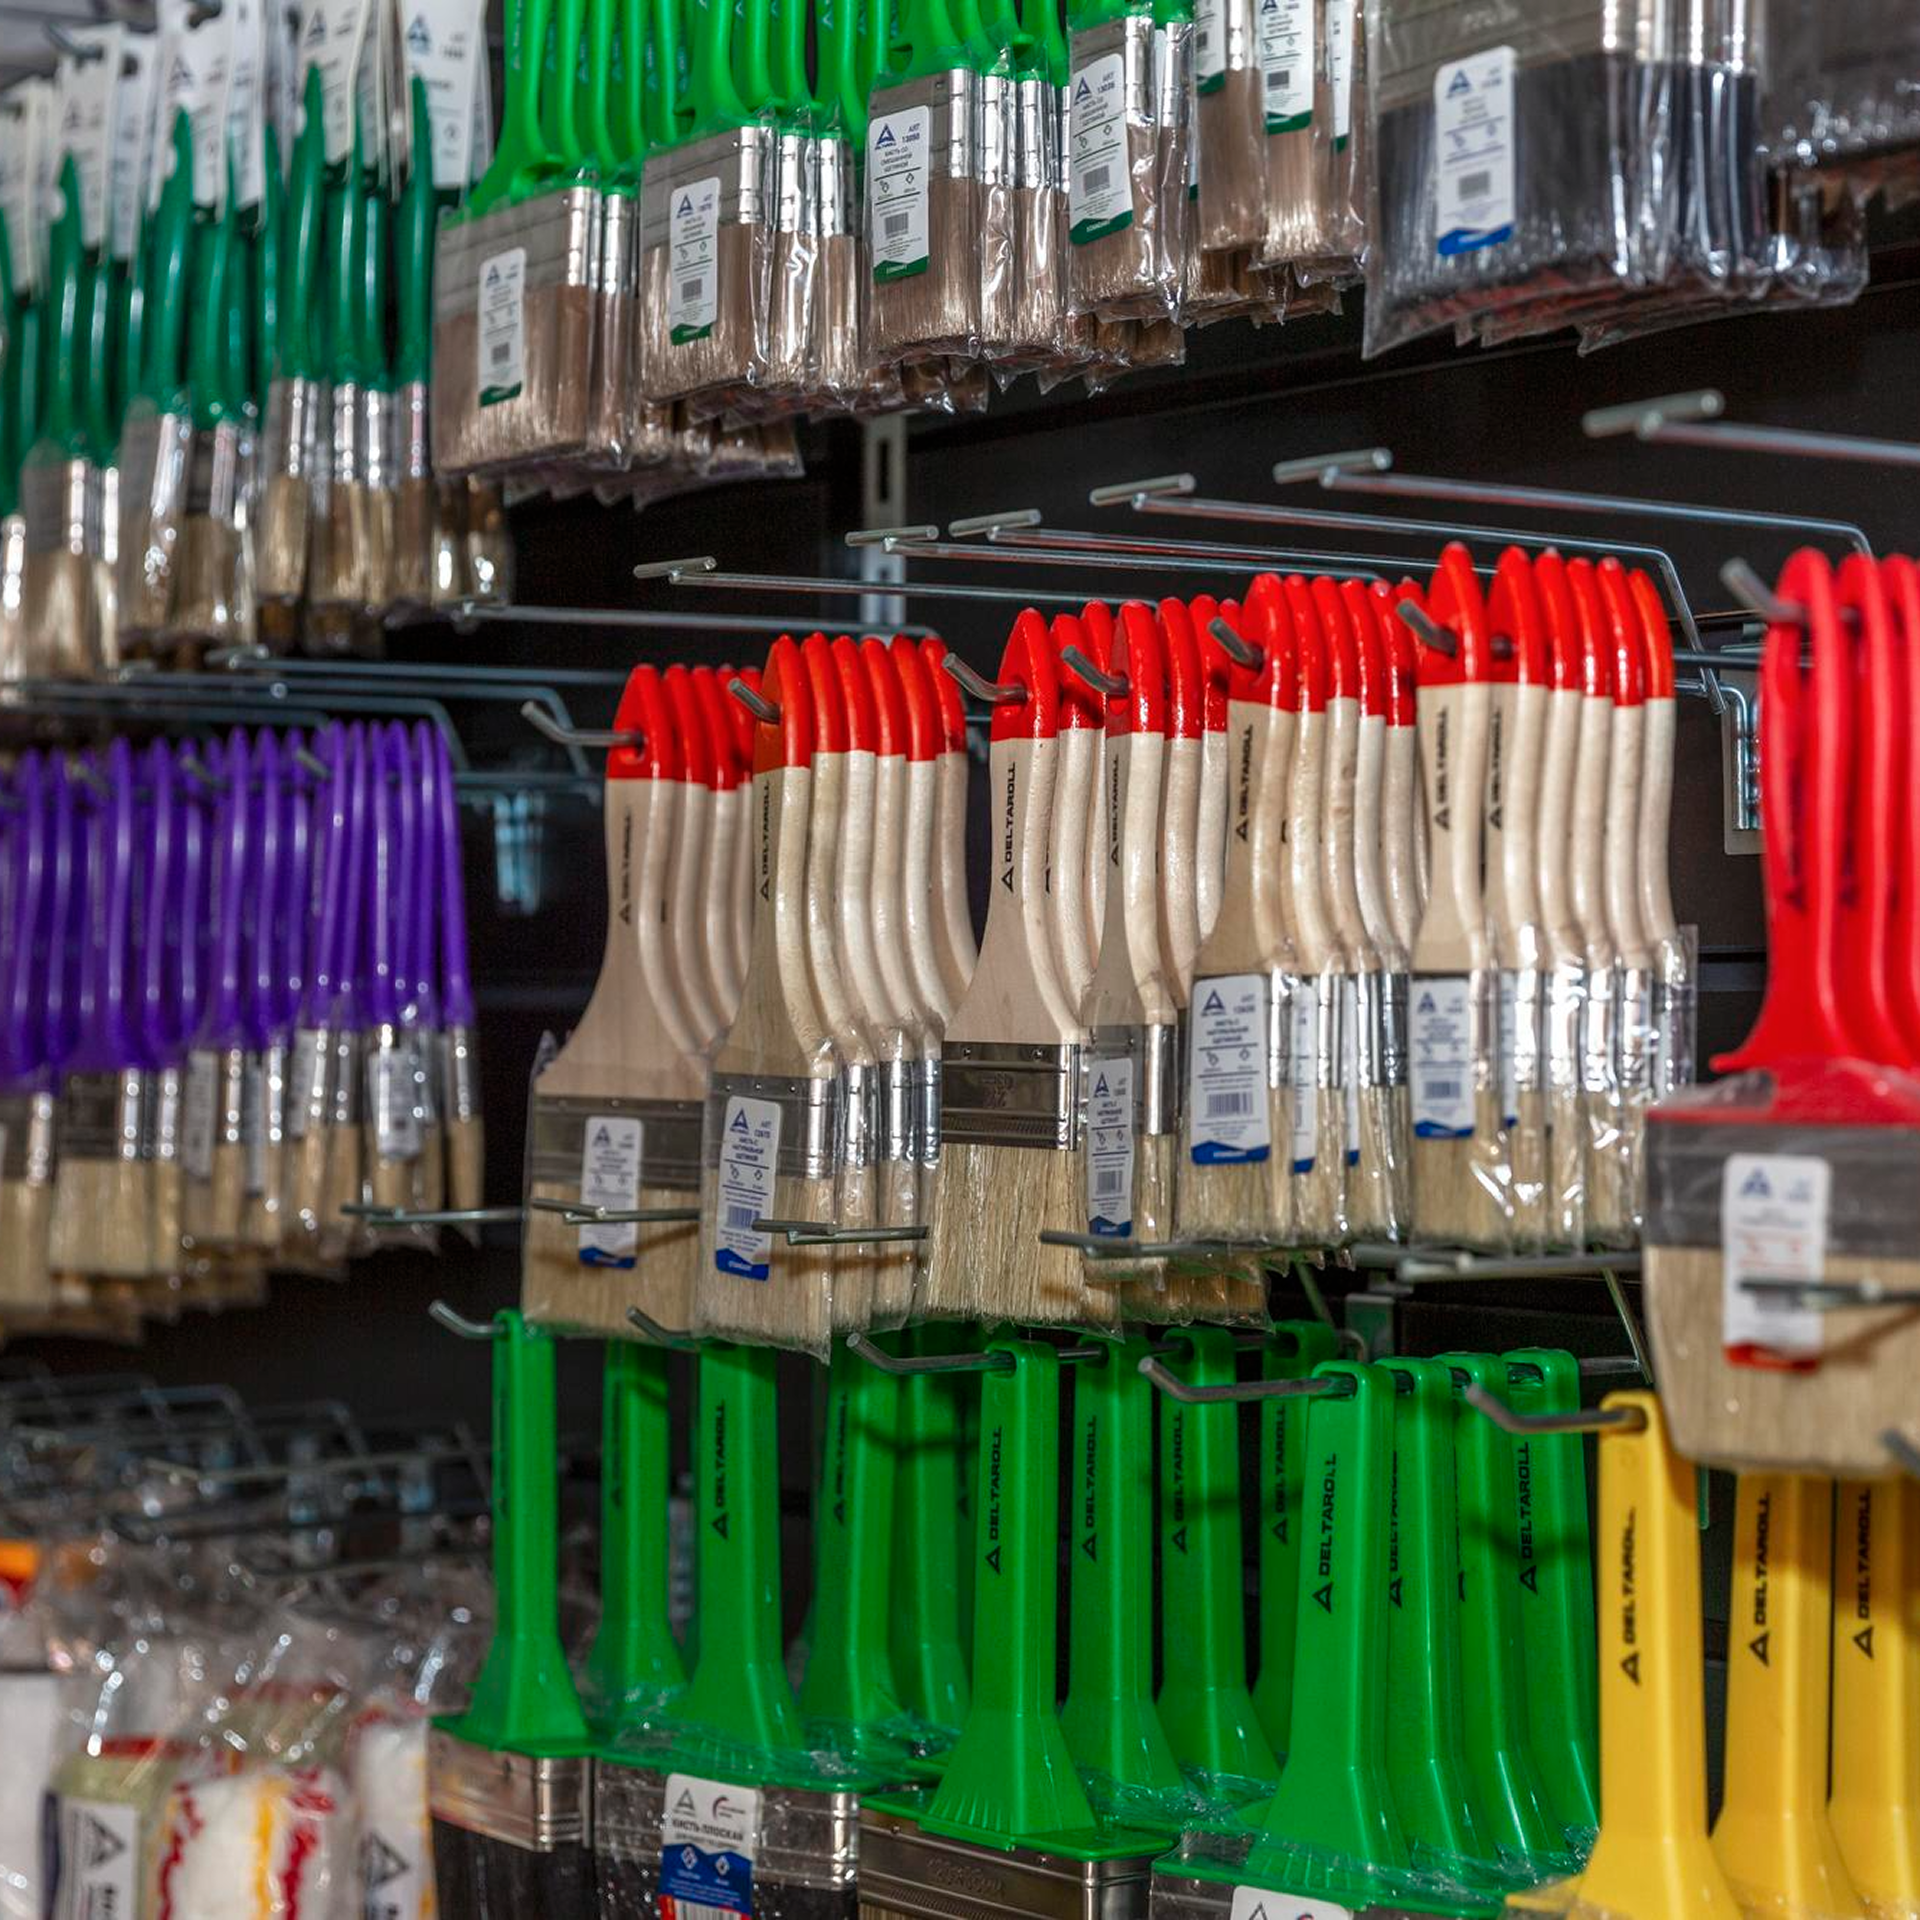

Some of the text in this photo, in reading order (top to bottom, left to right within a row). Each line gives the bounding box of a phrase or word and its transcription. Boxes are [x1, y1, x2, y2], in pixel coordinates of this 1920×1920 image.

[761, 780, 770, 876] DELTAROLL
[1005, 762, 1015, 863] DELTAROLL
[1239, 725, 1253, 816] DELTAROLL
[715, 1398, 726, 1508] DELTAROLL
[989, 1425, 1002, 1541] DELTAROLL
[1085, 1414, 1097, 1529] DELTAROLL
[1173, 1408, 1184, 1523] DELTAROLL
[1518, 1442, 1533, 1560] DELTAROLL
[1318, 1453, 1337, 1577] DELTAROLL
[1754, 1493, 1770, 1625] DELTAROLL
[1858, 1489, 1871, 1619] DELTAROLL
